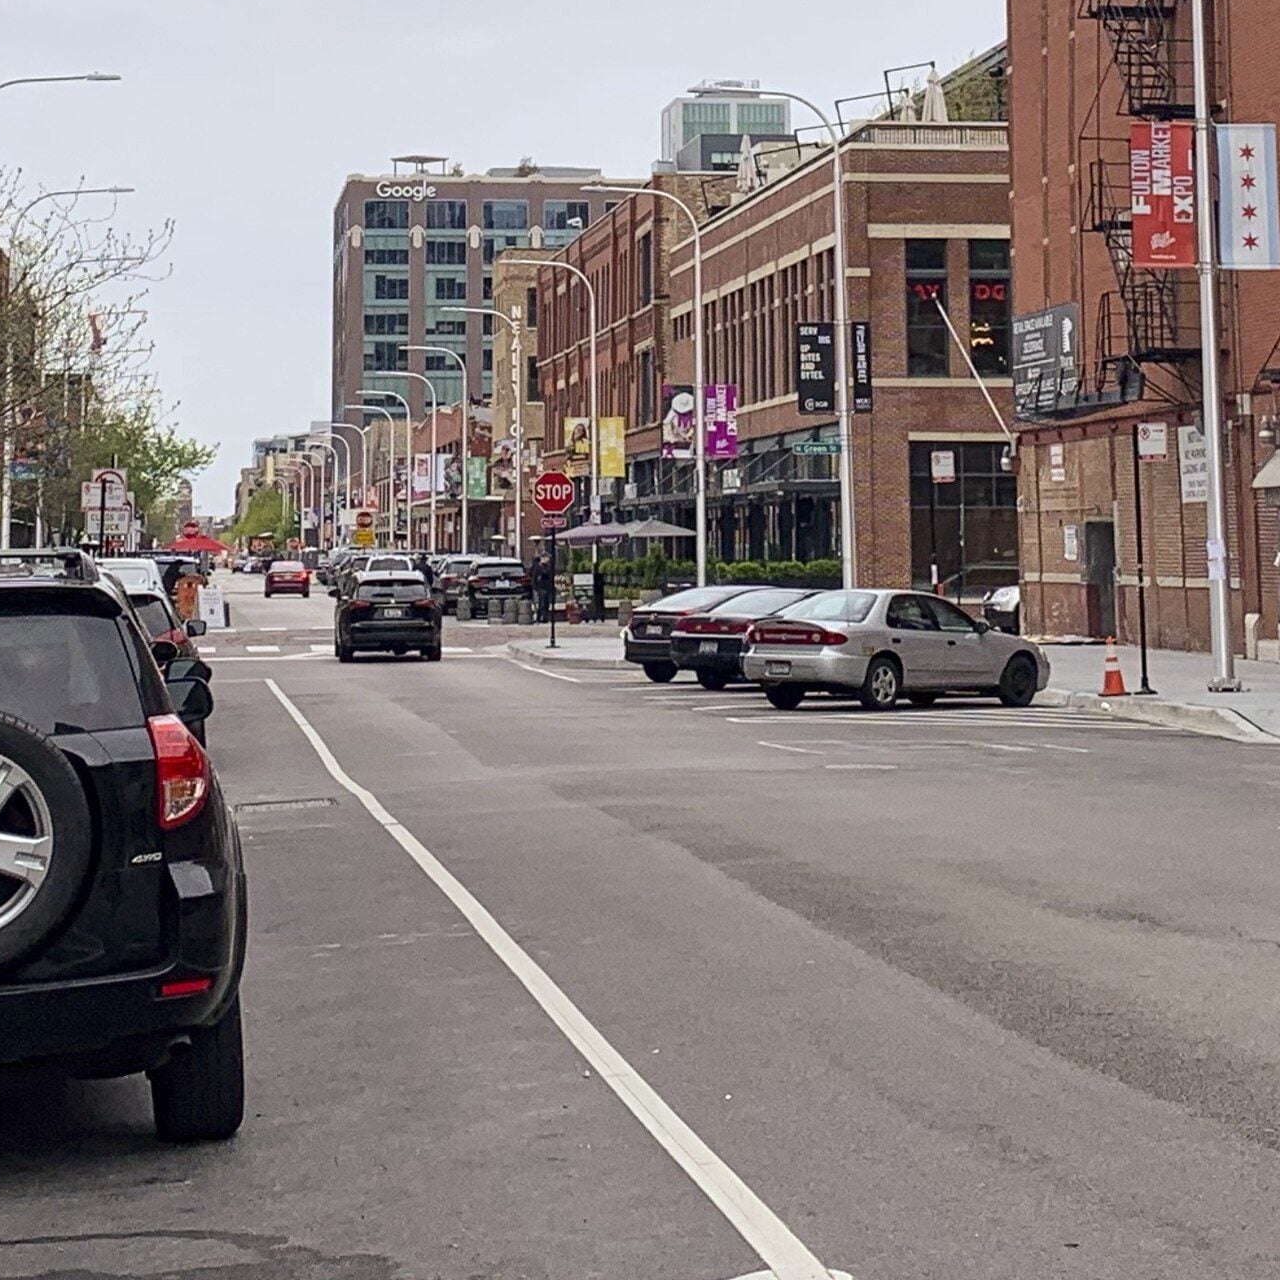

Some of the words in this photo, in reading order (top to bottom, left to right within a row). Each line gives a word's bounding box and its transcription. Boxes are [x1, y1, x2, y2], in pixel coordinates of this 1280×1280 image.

[1152, 120, 1172, 195] MARKET
[376, 174, 436, 202] Google
[1131, 149, 1151, 214] FULTON
[1173, 176, 1194, 223] EXPO
[803, 443, 828, 453] Green
[536, 484, 572, 500] STOP
[131, 852, 162, 864] 4WD
